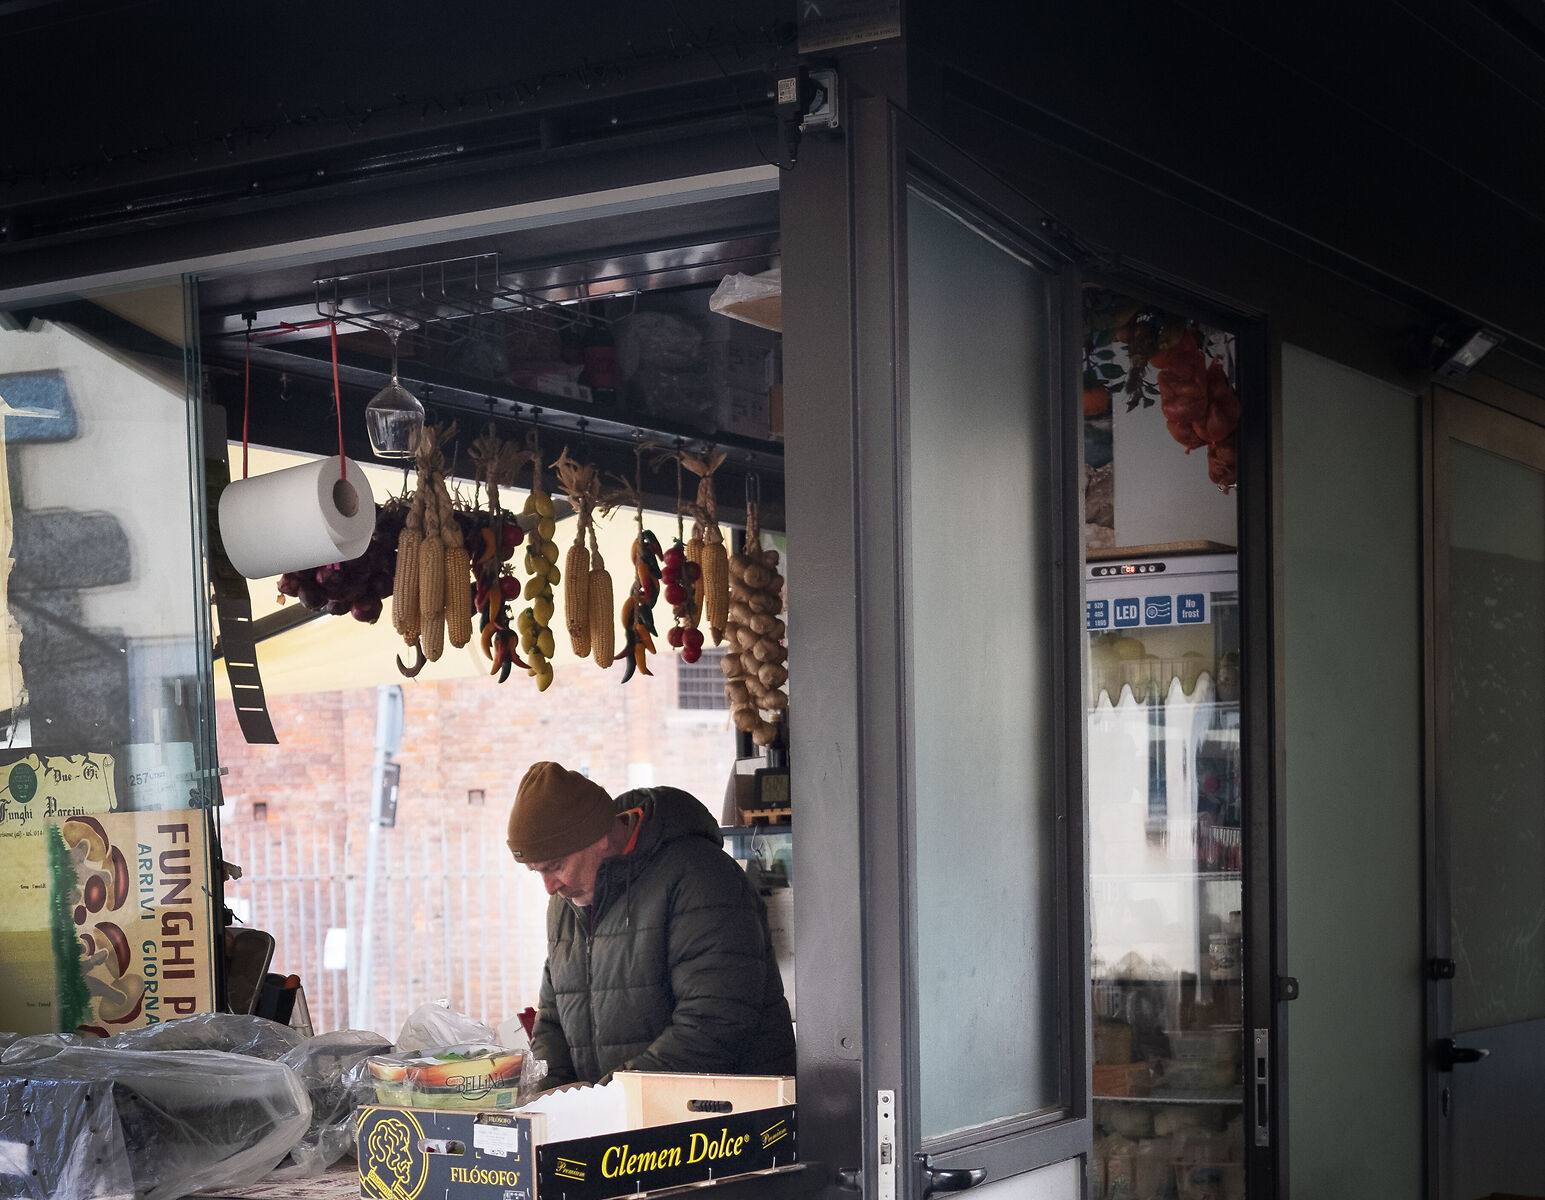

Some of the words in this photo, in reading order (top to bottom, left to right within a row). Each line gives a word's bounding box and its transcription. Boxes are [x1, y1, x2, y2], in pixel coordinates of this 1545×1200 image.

[1185, 599, 1196, 608] No
[1116, 606, 1137, 620] LED
[1182, 609, 1200, 619] frost
[137, 842, 156, 921] ARRIVI
[157, 822, 196, 980] FUNGHI
[761, 1128, 788, 1146] Premium
[556, 1160, 586, 1178] Premium
[601, 1144, 682, 1179] Clemen
[450, 1165, 517, 1187] FILÓSOFO
